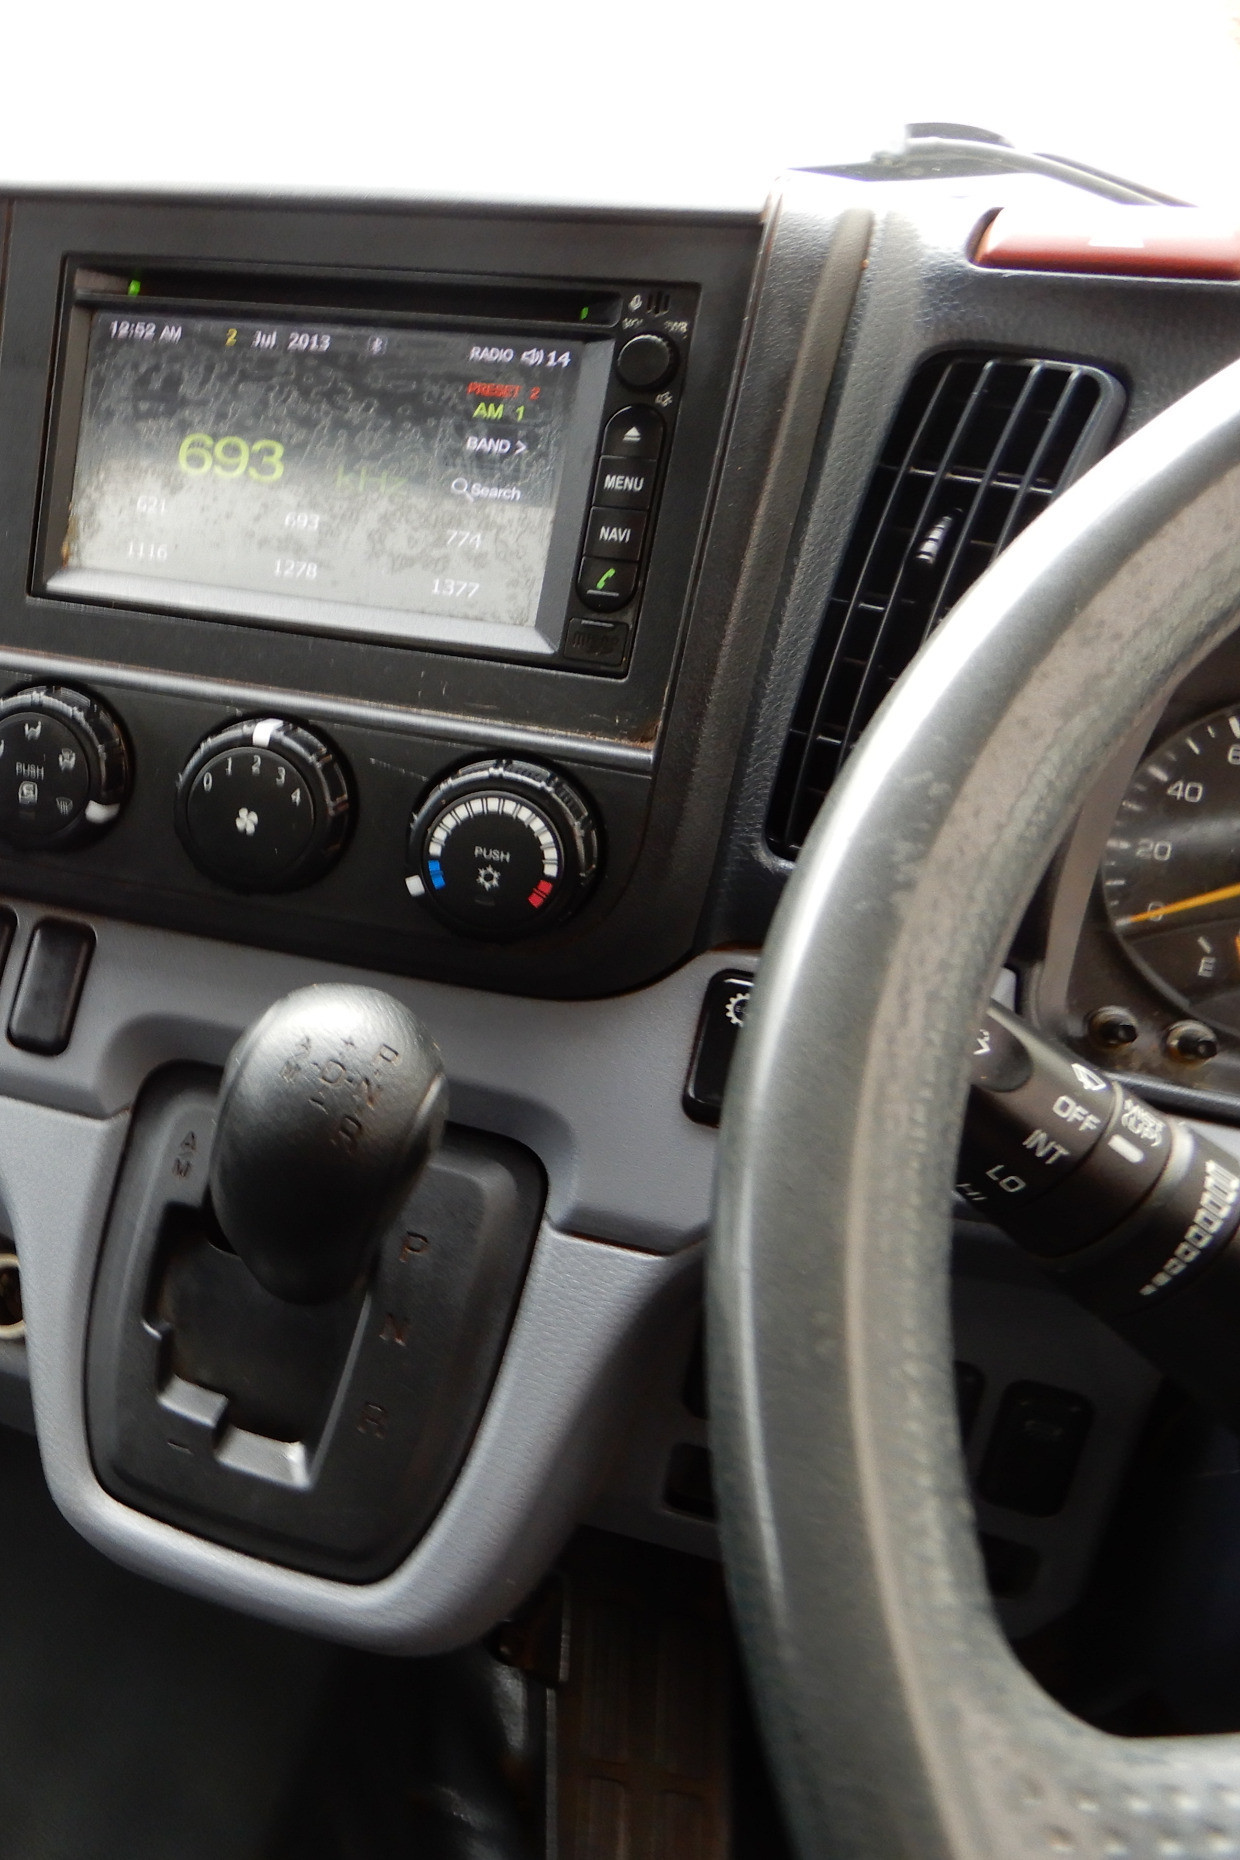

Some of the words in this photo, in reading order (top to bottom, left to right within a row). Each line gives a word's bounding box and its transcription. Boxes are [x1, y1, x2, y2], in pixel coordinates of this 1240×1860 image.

[110, 320, 157, 340] 12:52
[159, 324, 183, 343] AM
[224, 328, 239, 347] 2
[251, 330, 277, 349] Jul
[287, 332, 331, 353] 2013
[468, 346, 514, 363] RADIO
[545, 350, 571, 368] 14
[466, 381, 523, 399] PRESET
[528, 386, 542, 401] 2
[472, 402, 505, 420] AM
[515, 405, 526, 422] 1
[465, 436, 511, 454] BAND
[177, 432, 286, 484] 693
[470, 483, 522, 501] Search
[603, 474, 645, 492] MENU
[283, 511, 321, 531] 693
[445, 529, 483, 549] 774
[598, 525, 632, 544] NAVI
[128, 540, 168, 562] 1116
[274, 558, 319, 581] 1278
[431, 577, 481, 599] 1377
[15, 761, 45, 781] PUSH
[203, 771, 213, 793] 0
[225, 756, 233, 776] 1
[251, 754, 262, 776] 2
[275, 766, 286, 788] 3
[291, 787, 301, 807] 4
[1166, 779, 1204, 804] 40
[474, 845, 511, 863] PUSH
[1135, 838, 1173, 862] 20
[1198, 956, 1217, 978] E
[1052, 1094, 1102, 1132] OFF
[1021, 1128, 1072, 1165] INT
[985, 1164, 1027, 1193] LO
[398, 1230, 429, 1263] P
